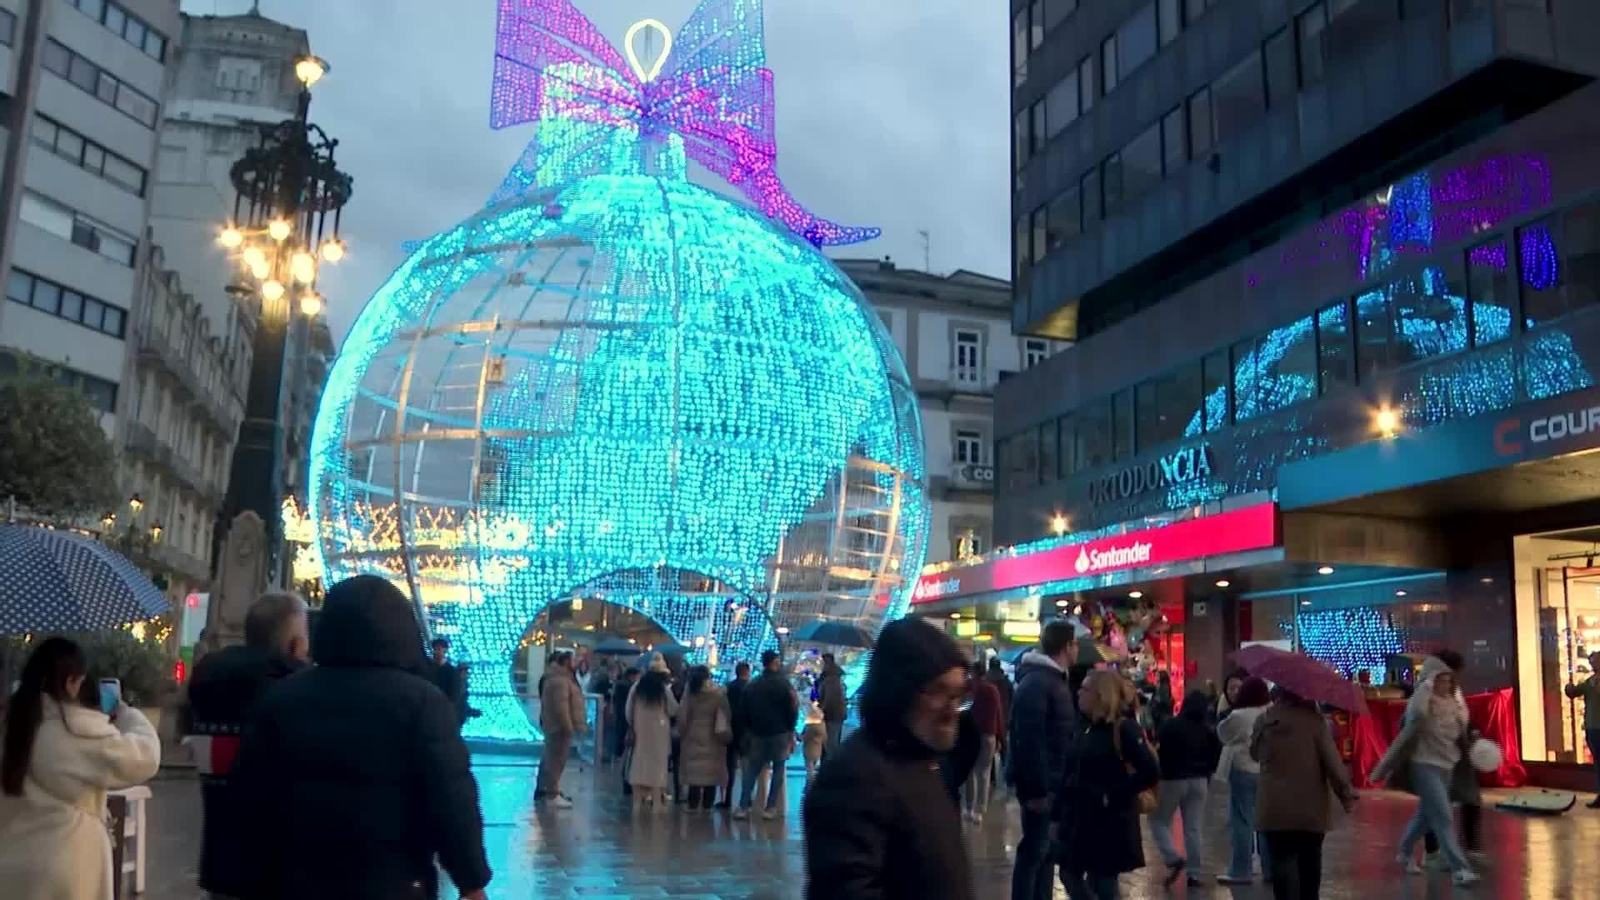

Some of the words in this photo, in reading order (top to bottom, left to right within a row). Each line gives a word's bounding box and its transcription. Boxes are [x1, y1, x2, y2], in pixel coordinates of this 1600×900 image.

[1088, 440, 1211, 506] ORTODONCIA
[1089, 540, 1152, 571] Santander
[923, 578, 961, 598] Santander
